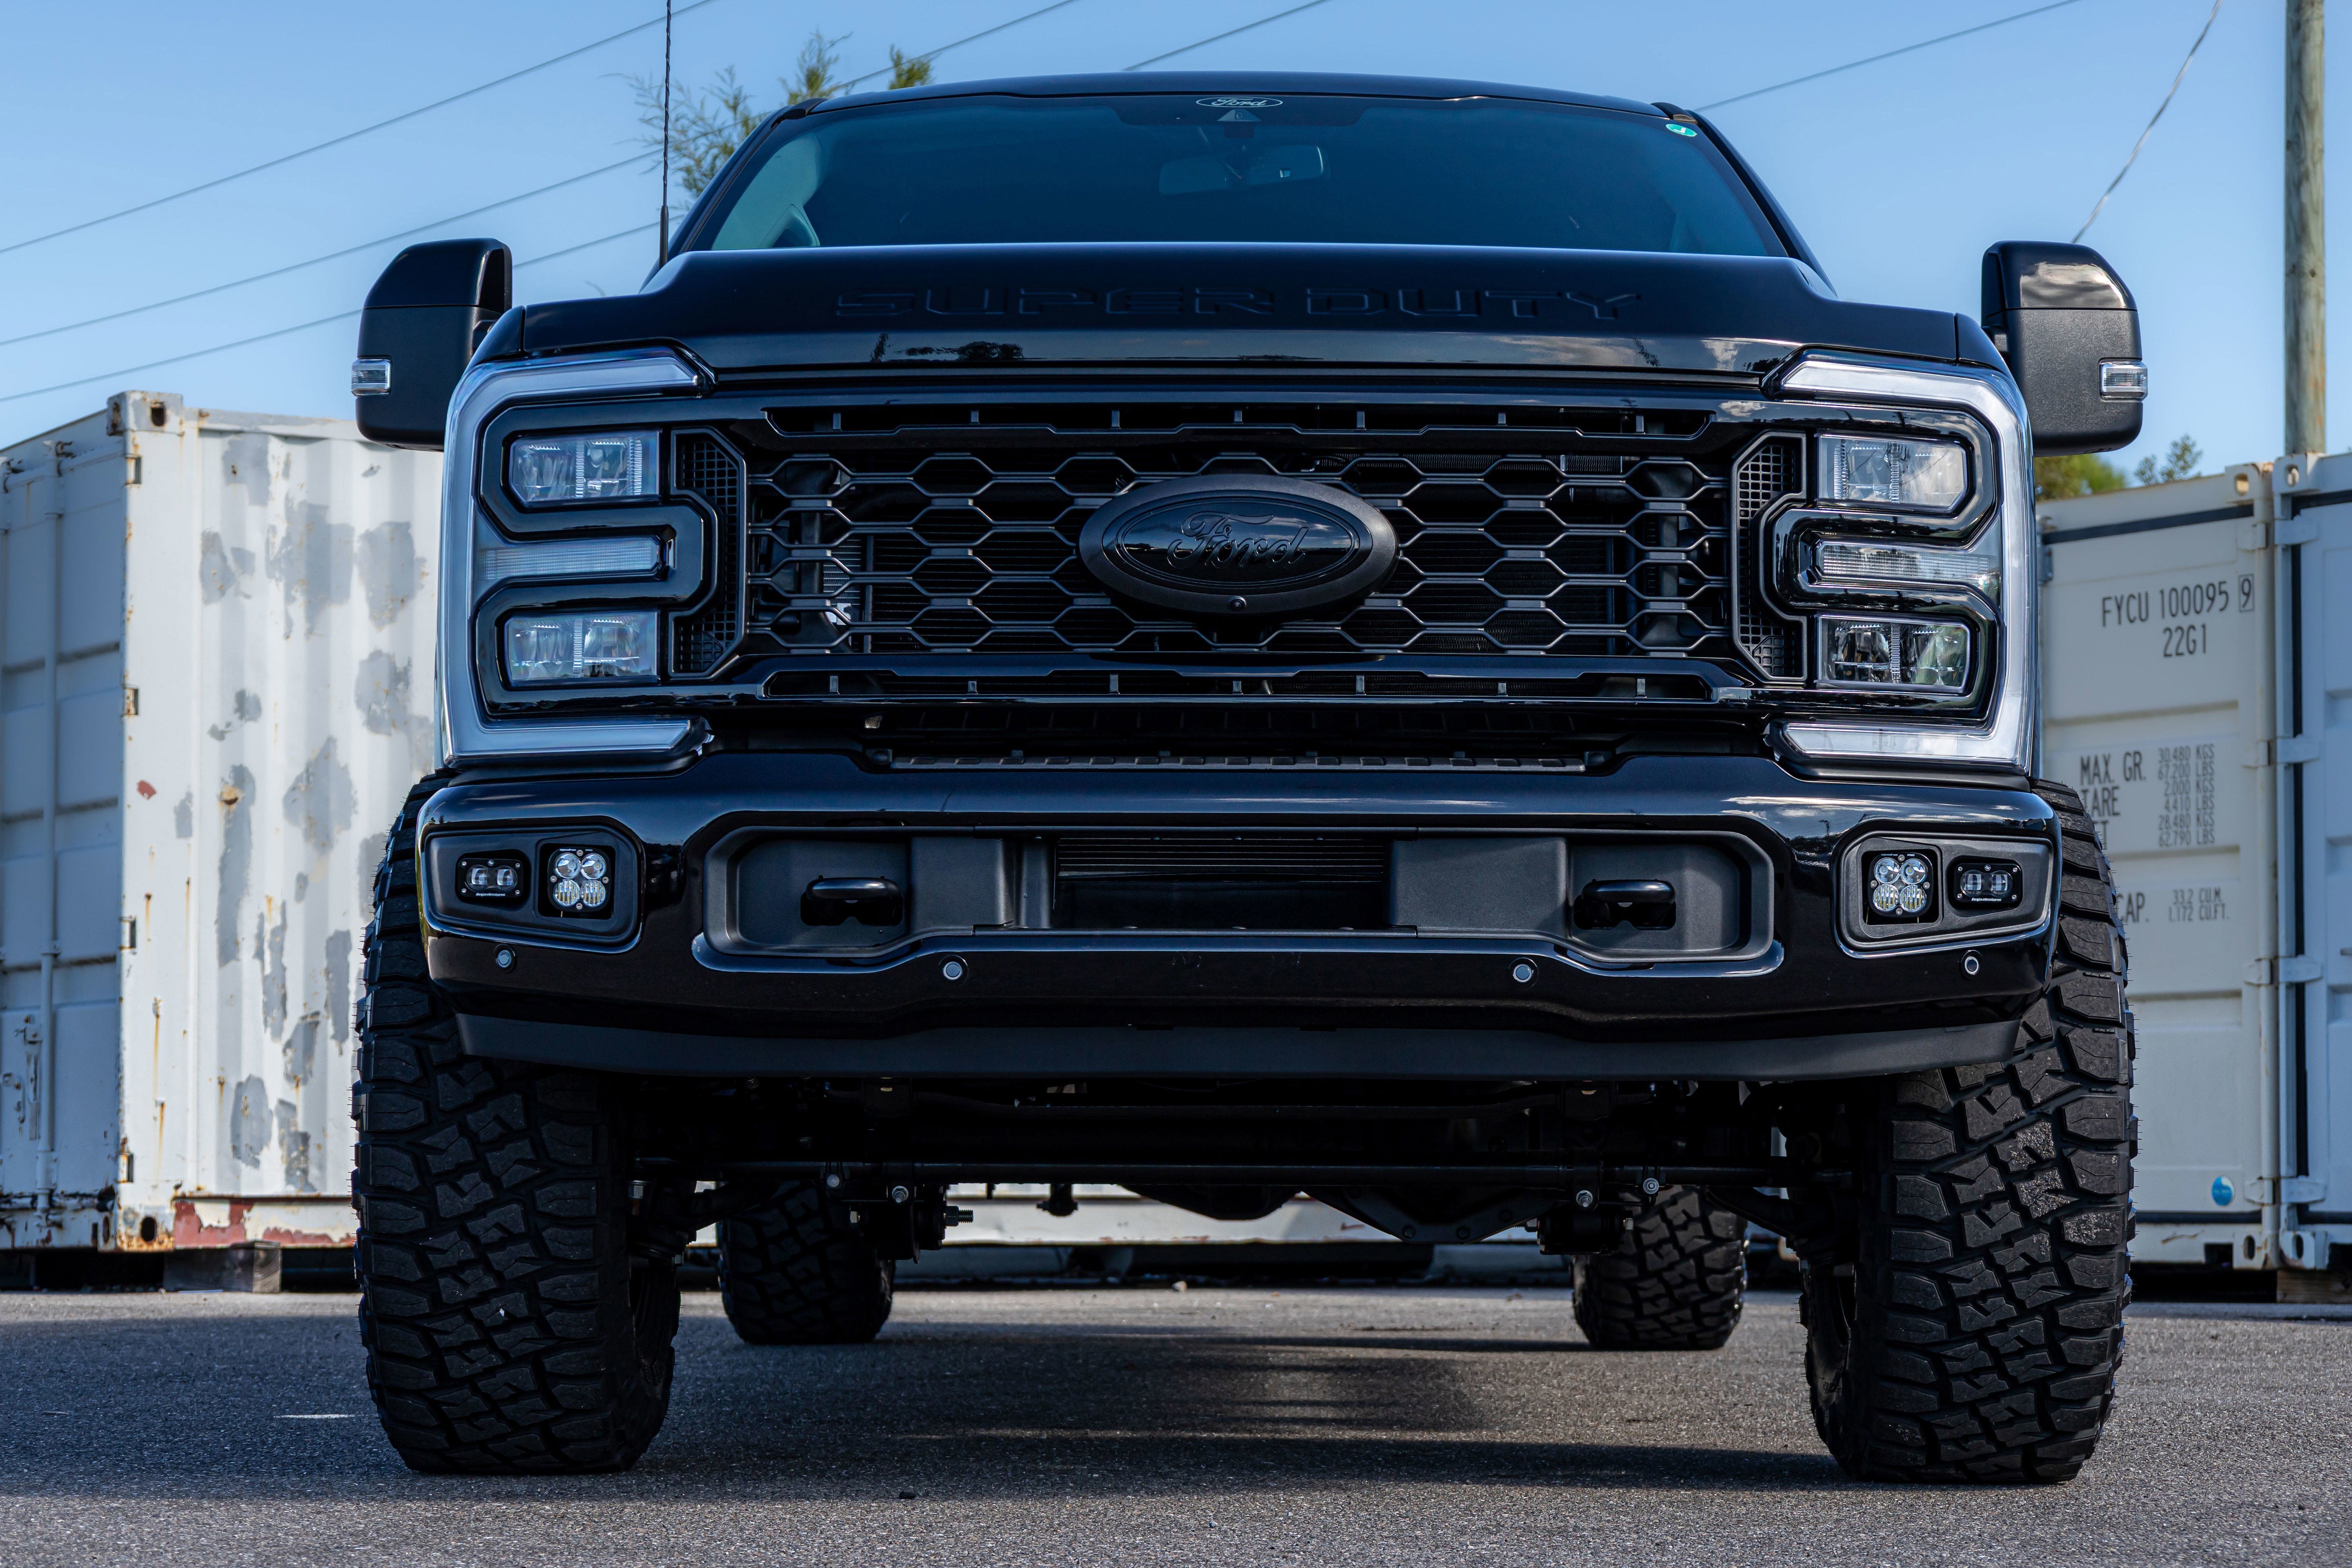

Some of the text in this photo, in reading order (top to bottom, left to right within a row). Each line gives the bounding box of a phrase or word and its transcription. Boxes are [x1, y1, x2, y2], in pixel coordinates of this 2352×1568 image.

[1211, 98, 1267, 106] Ford
[836, 288, 1642, 319] SUPER DUTY
[1167, 511, 1309, 569] Ford
[2102, 577, 2252, 626] FYCU 100095 9
[2163, 623, 2206, 657] 22G1
[2196, 743, 2215, 760] KGS
[2080, 750, 2146, 785] MAX. GR.
[2196, 760, 2214, 777] LBS
[2196, 777, 2215, 793] KGS
[2081, 785, 2120, 817] TARE
[2196, 794, 2214, 811] LBS
[2196, 810, 2215, 827] KGS
[2196, 827, 2215, 844] LBS
